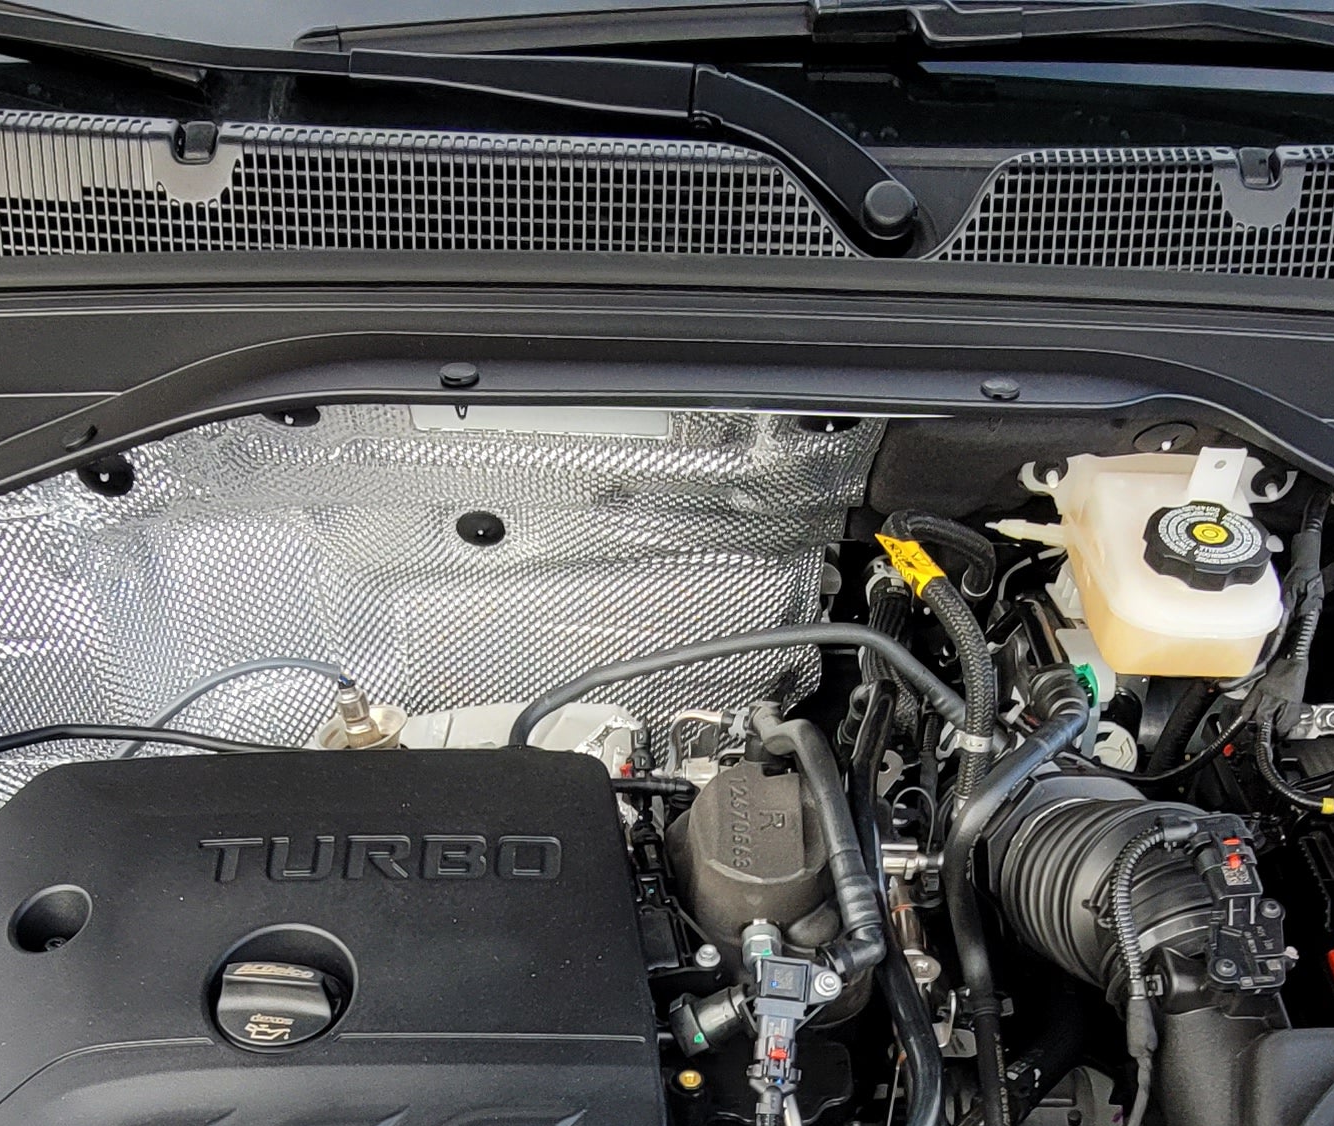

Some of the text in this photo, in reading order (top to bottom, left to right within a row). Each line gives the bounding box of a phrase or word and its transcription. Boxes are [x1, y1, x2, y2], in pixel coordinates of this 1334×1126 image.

[759, 810, 786, 831] R
[199, 835, 562, 881] TURBO
[233, 964, 315, 978] ACDelco
